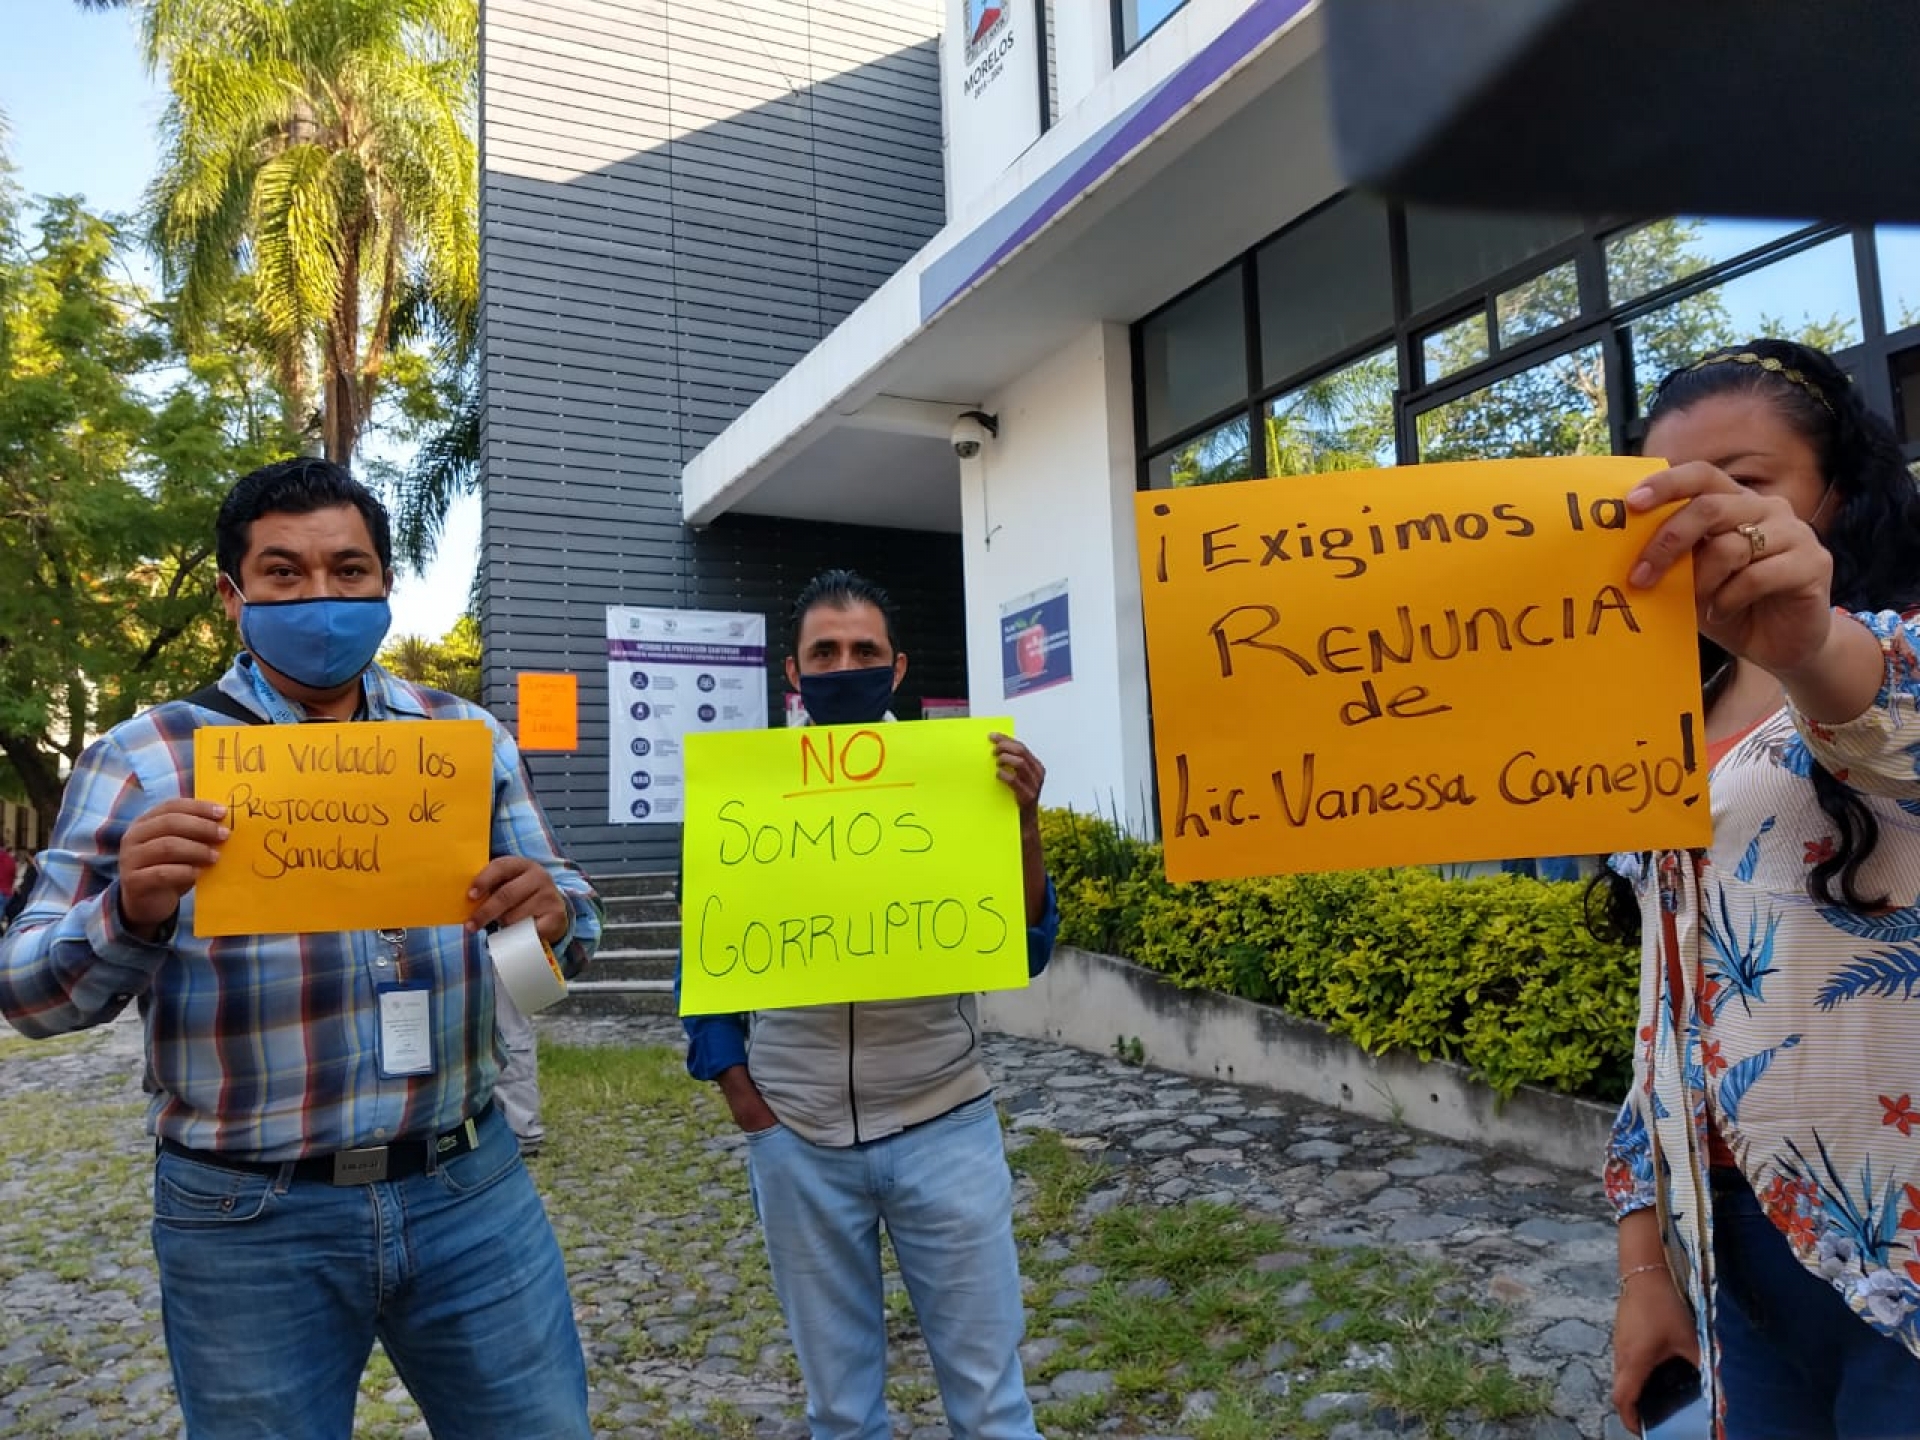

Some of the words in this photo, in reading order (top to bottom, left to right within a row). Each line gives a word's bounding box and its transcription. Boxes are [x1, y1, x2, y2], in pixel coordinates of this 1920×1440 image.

[964, 29, 1014, 96] MORELOS
[1567, 491, 1627, 531] la
[1208, 584, 1641, 678] RENUNCIA
[1339, 680, 1452, 726] de
[212, 732, 266, 774] Ha
[418, 737, 456, 779] los
[800, 730, 886, 786] NO
[409, 788, 446, 824] de
[1271, 752, 1477, 827] Vanessa
[252, 828, 380, 879] Sanidad
[717, 800, 934, 866] SOMOS
[699, 894, 1008, 978] CORRUPTOS
